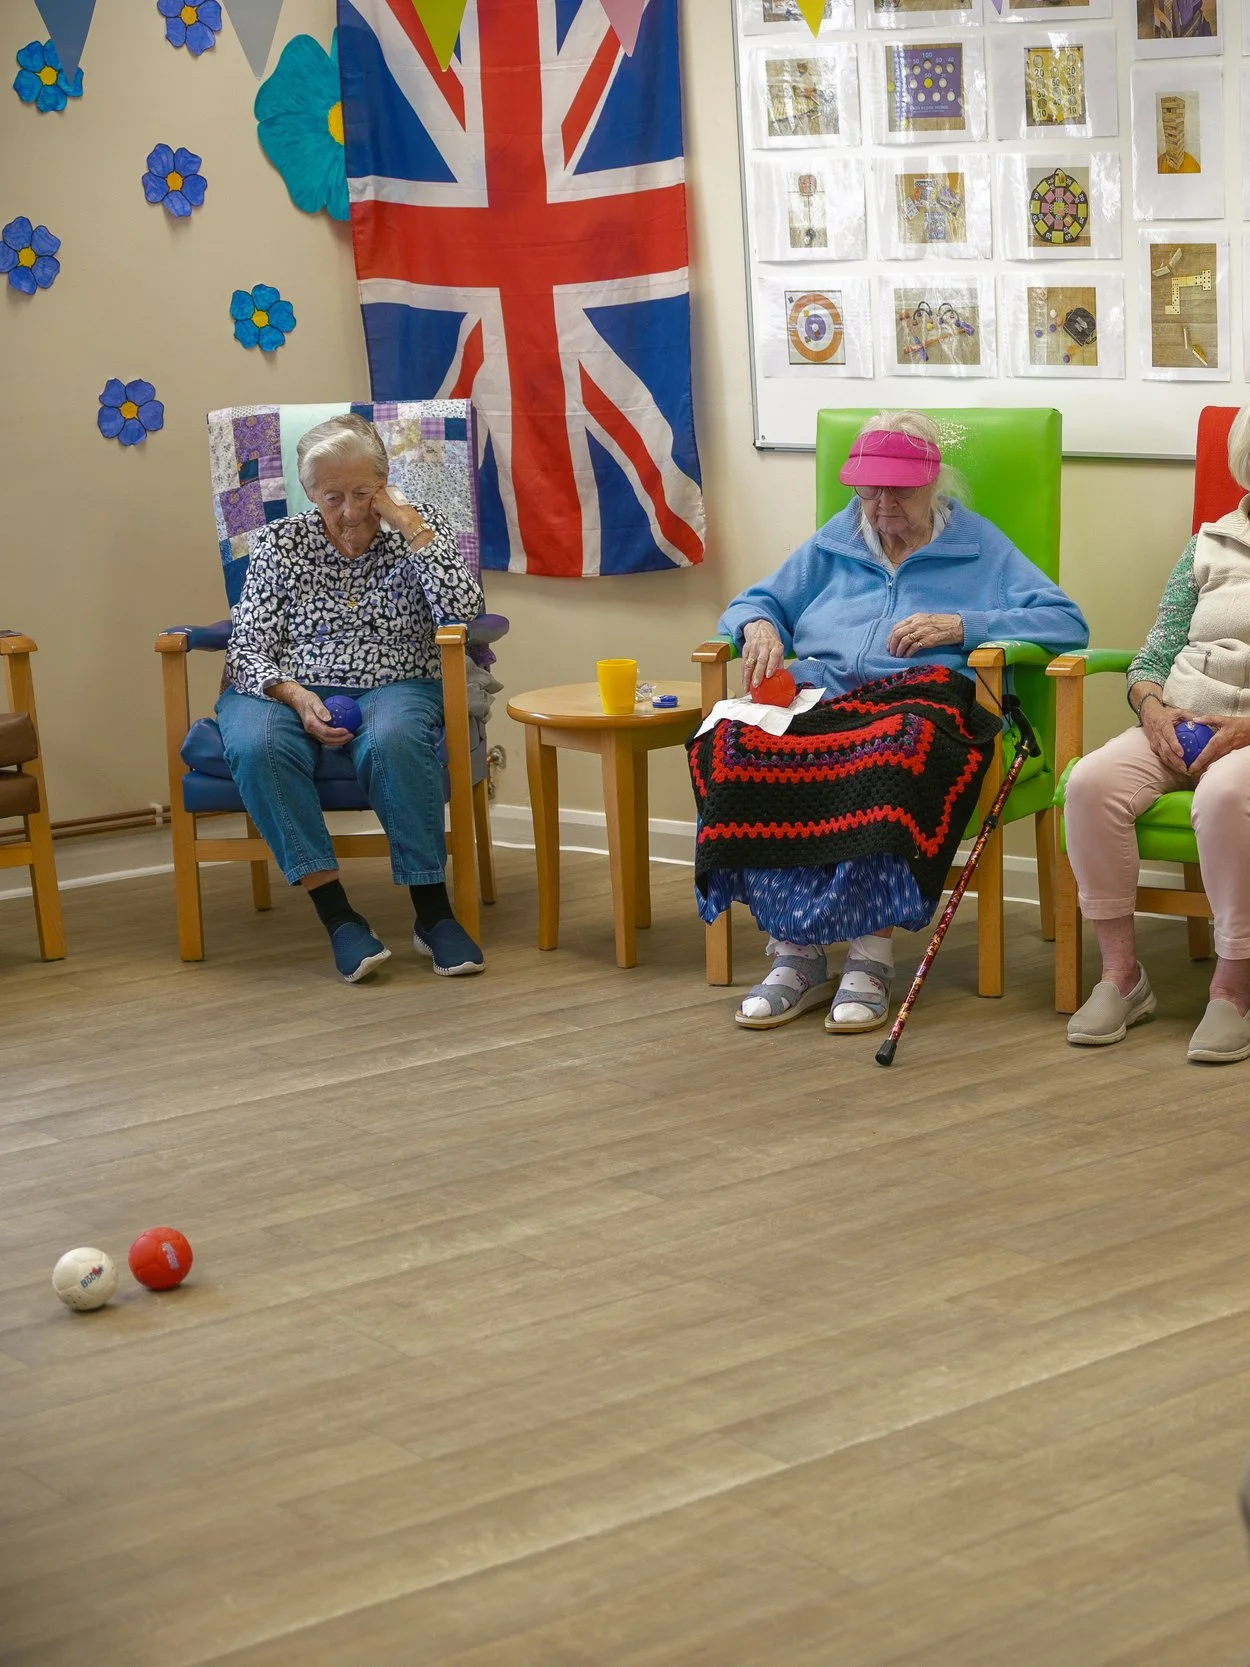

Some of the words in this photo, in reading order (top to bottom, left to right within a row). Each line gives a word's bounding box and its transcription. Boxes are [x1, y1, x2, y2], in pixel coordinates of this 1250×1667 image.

[1034, 69, 1045, 77] 20
[1066, 67, 1076, 75] 20
[1052, 79, 1060, 87] 50
[1036, 90, 1046, 98] 30
[1067, 88, 1076, 96] 30
[1038, 109, 1047, 118] 10
